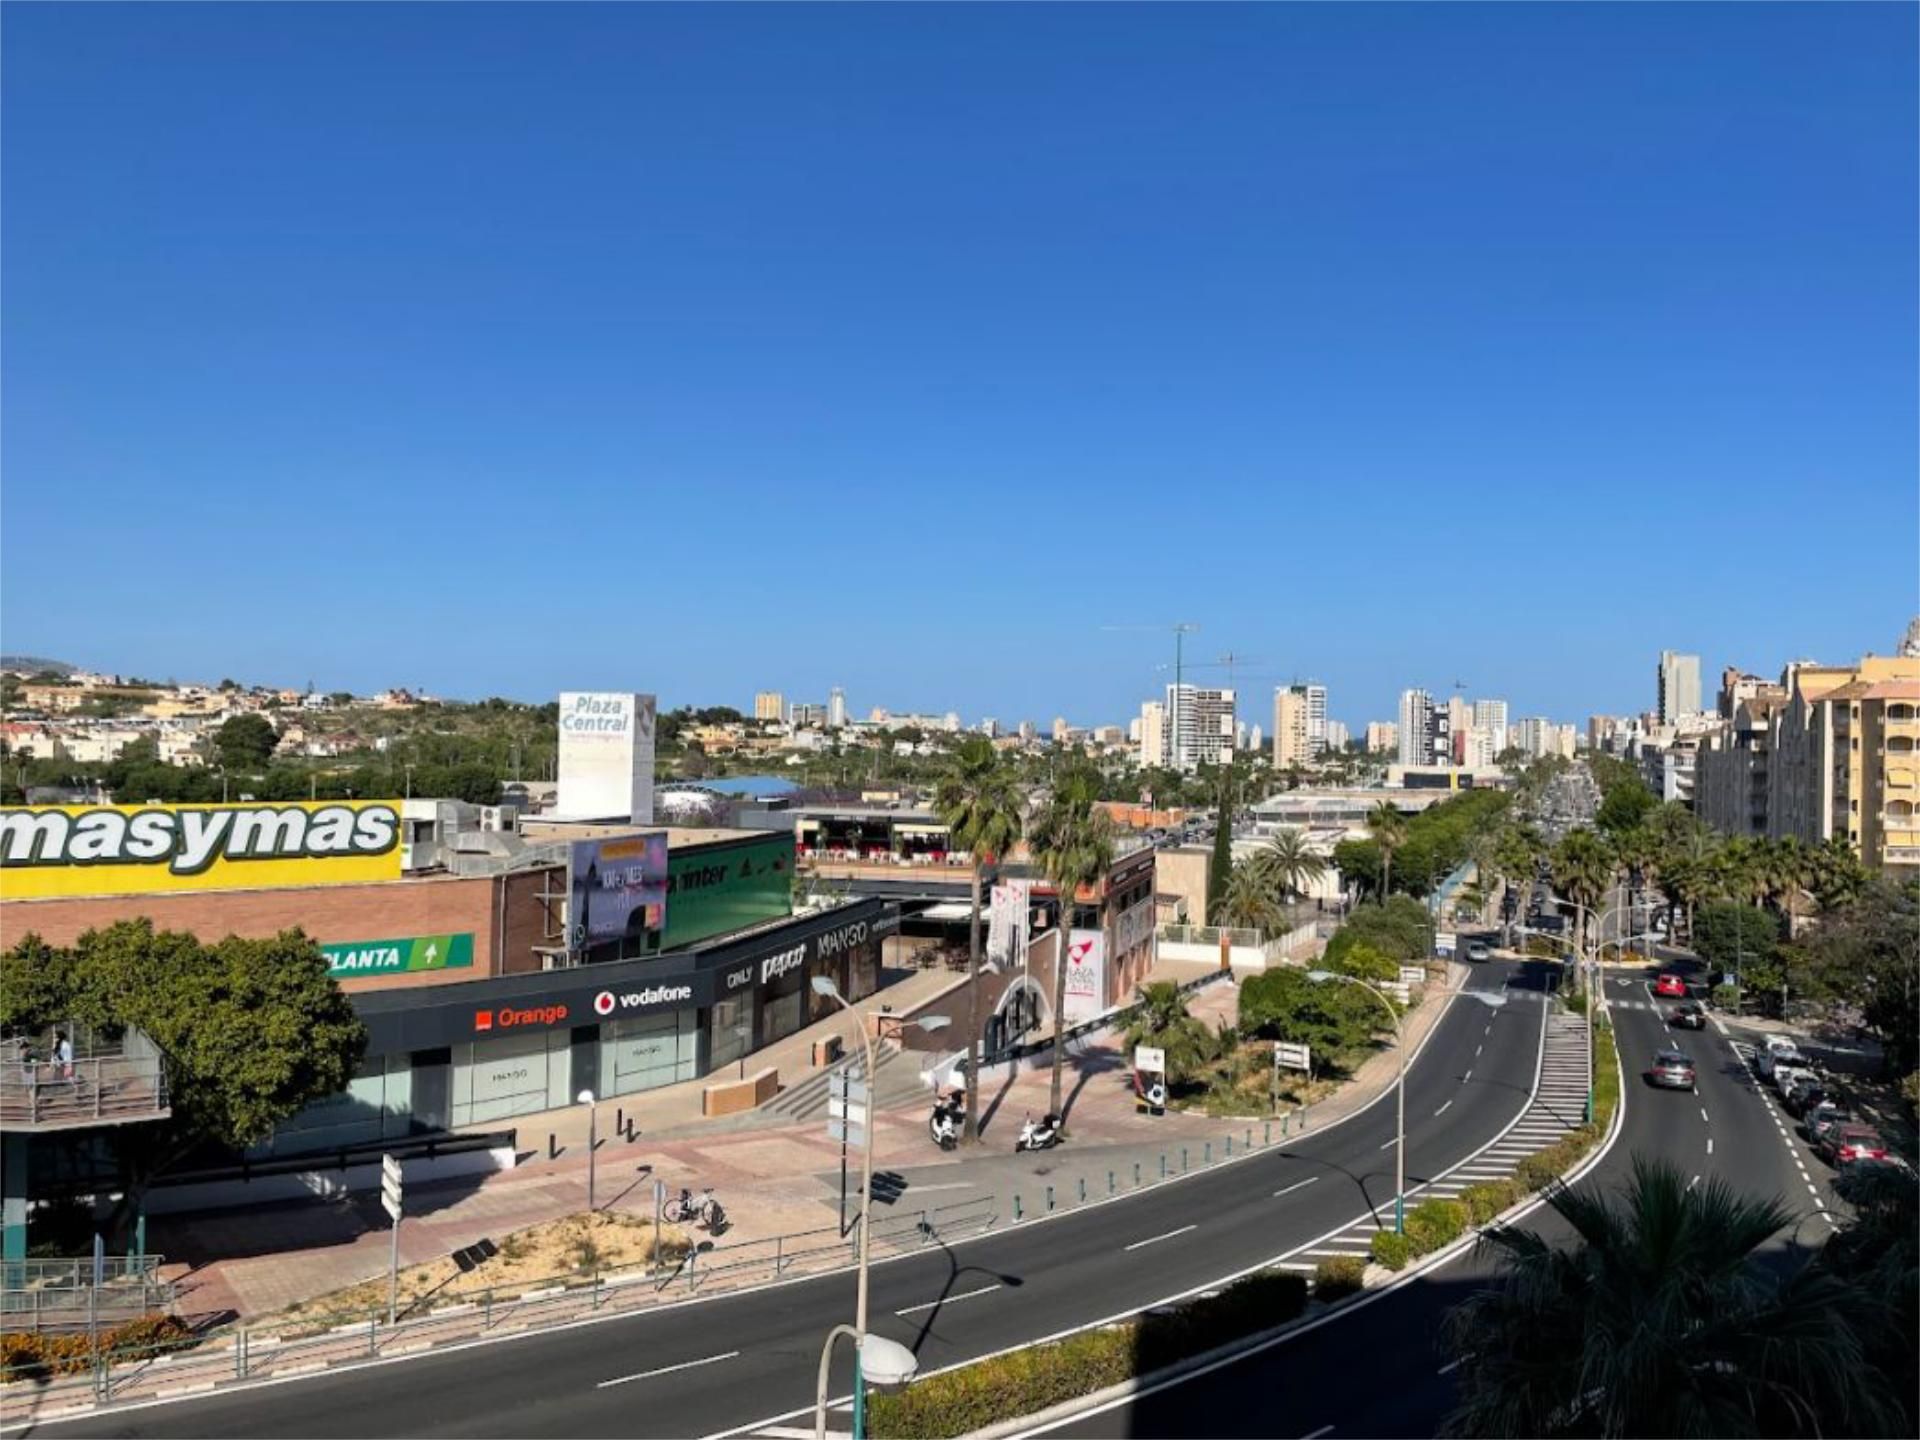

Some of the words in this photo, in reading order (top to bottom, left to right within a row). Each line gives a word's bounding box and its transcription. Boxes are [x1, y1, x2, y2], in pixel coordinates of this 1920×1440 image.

[575, 696, 622, 714] Plaza
[563, 713, 628, 731] Central
[0, 805, 399, 873] masymas
[761, 945, 805, 984] pepco
[619, 984, 691, 1009] vodafone
[498, 1004, 568, 1027] Orange
